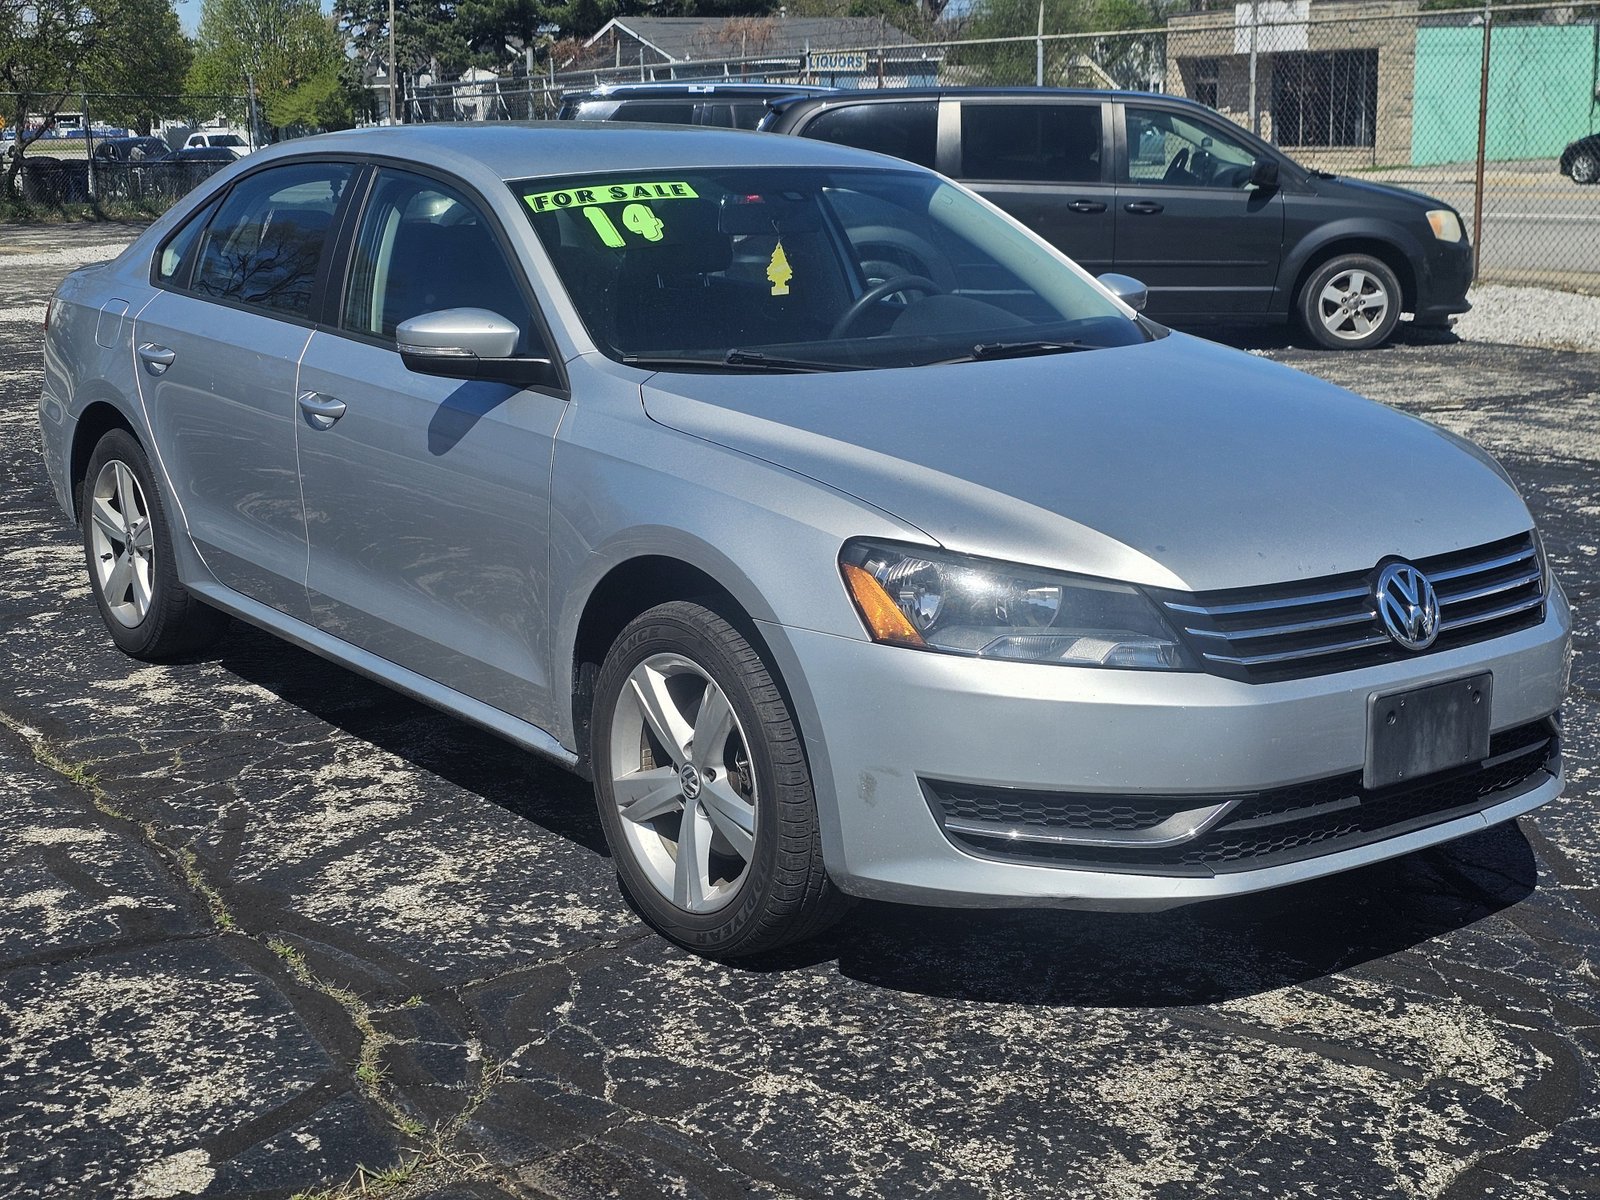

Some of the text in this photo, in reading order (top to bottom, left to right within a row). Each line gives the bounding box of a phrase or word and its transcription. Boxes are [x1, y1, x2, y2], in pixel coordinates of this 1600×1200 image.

[808, 55, 863, 68] LIQUORS
[532, 183, 688, 212] FOR SALE
[582, 203, 665, 248] 14
